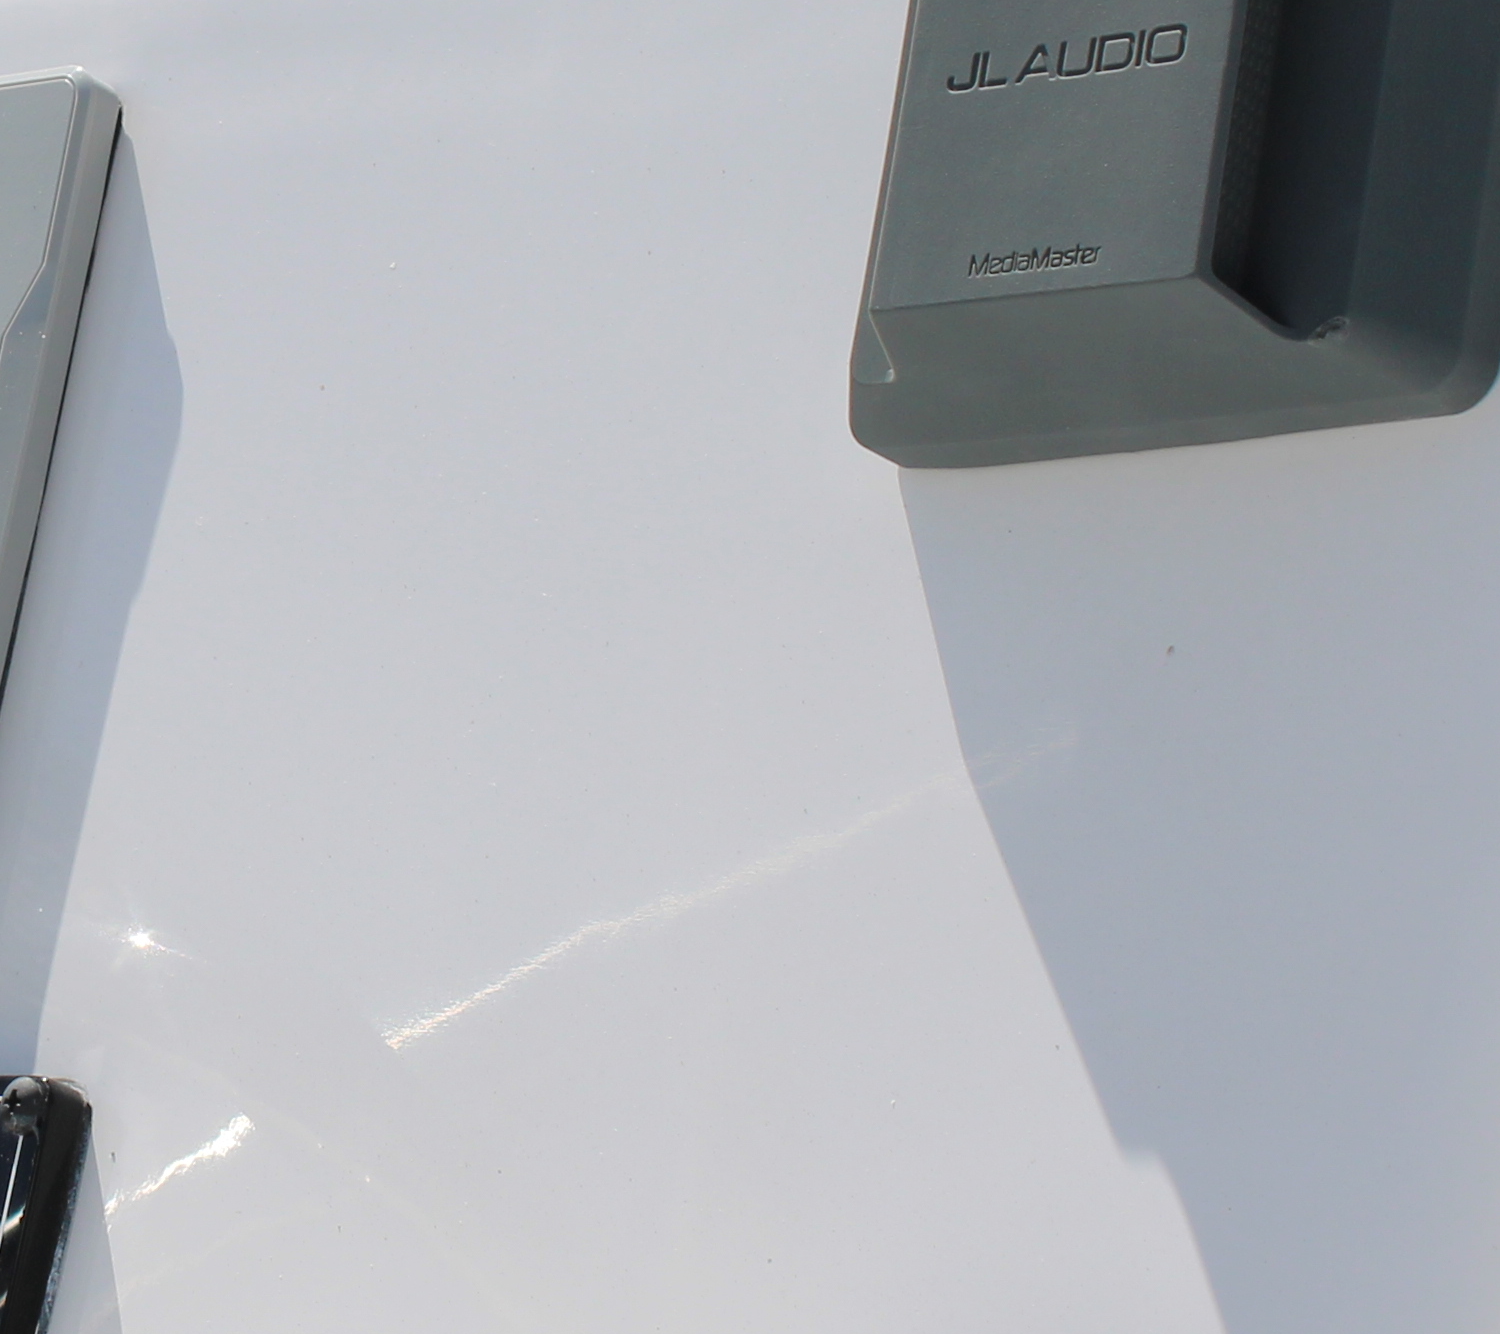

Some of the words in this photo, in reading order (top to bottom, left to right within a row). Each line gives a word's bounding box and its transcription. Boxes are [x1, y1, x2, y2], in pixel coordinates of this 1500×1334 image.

[946, 50, 1007, 94] JL
[1014, 23, 1188, 86] AUDIO
[967, 243, 1102, 278] MediaMaster
